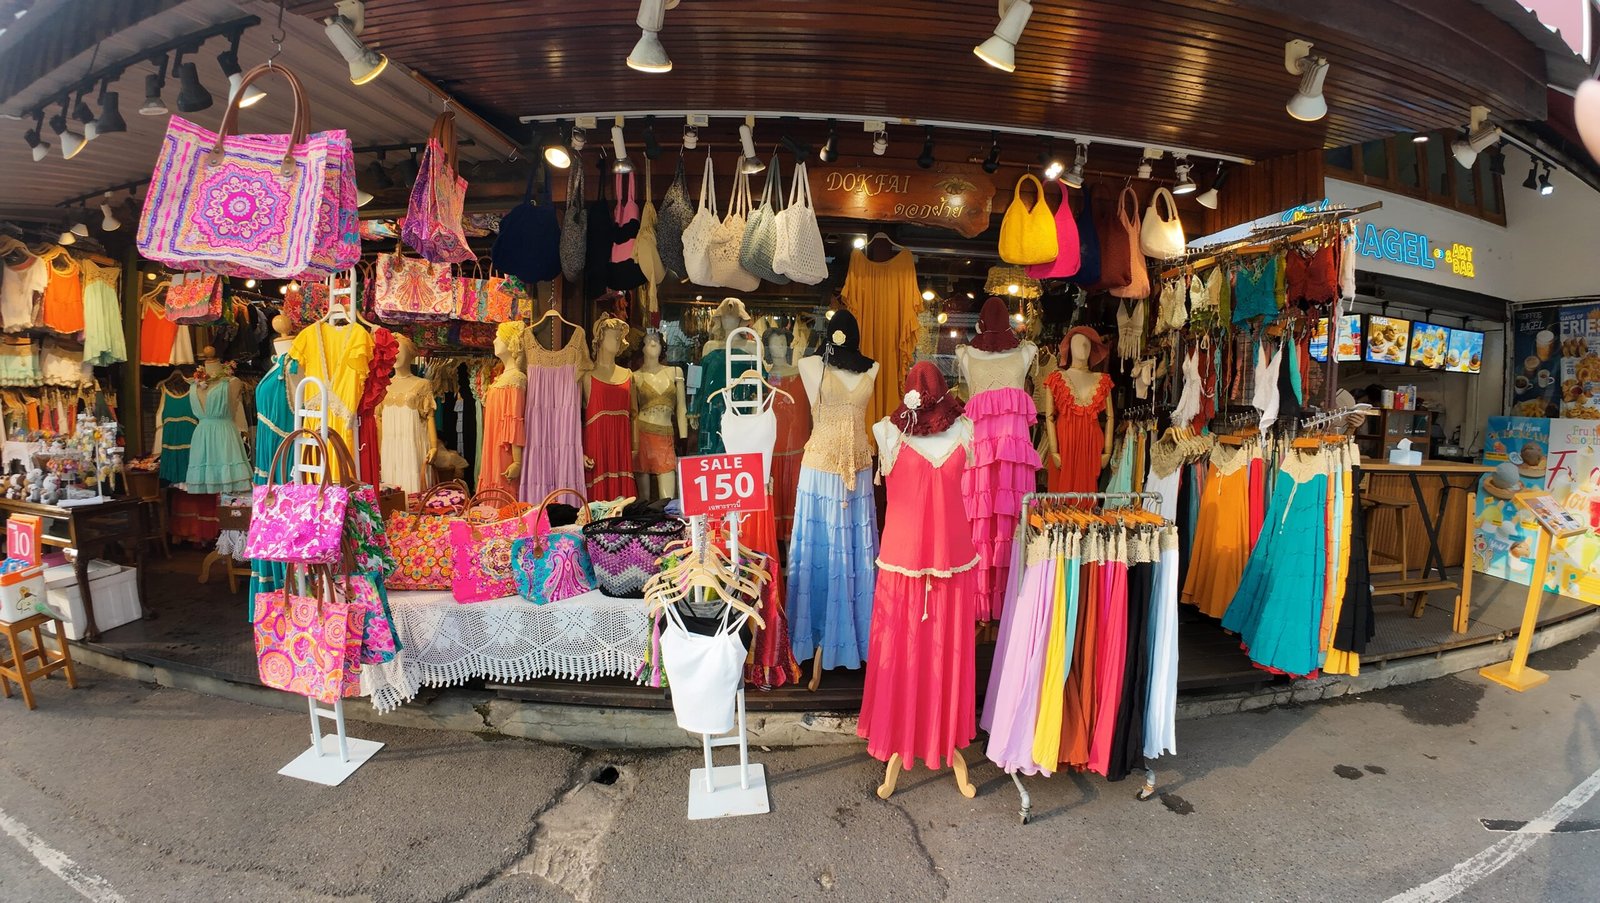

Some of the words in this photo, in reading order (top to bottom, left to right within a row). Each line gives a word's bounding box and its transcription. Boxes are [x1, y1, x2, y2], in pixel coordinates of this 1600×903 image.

[894, 197, 966, 219] ดอกฝ้าย
[1354, 223, 1435, 269] AGEL
[1452, 243, 1473, 262] ART
[700, 457, 743, 472] SALE
[693, 471, 755, 502] 150
[14, 530, 30, 557] 10
